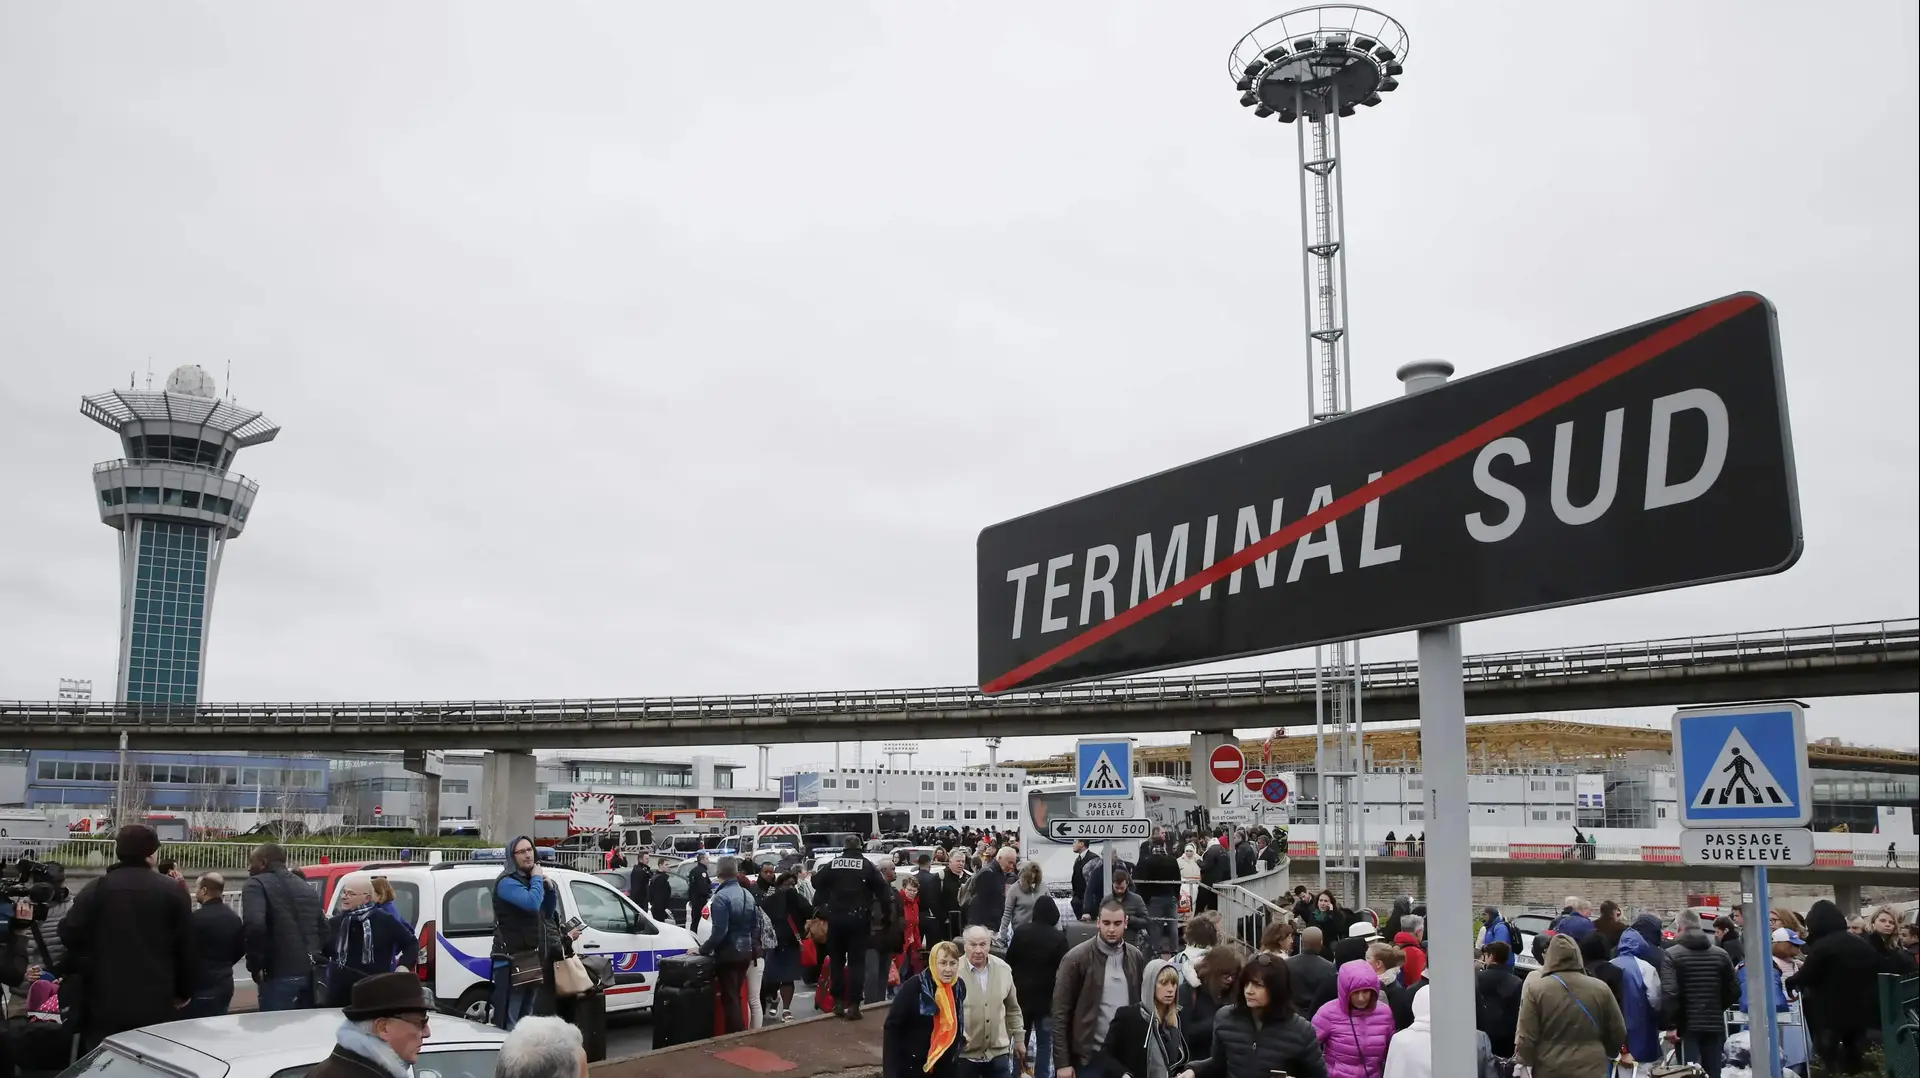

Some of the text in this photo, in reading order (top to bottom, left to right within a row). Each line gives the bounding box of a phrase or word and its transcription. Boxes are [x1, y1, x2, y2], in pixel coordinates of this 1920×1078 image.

[1005, 387, 1730, 640] TERMINAL SUD
[1078, 825, 1145, 834] SALON 500
[1705, 834, 1783, 845] PASSAGE
[1701, 846, 1791, 860] SURÉLEVÉ
